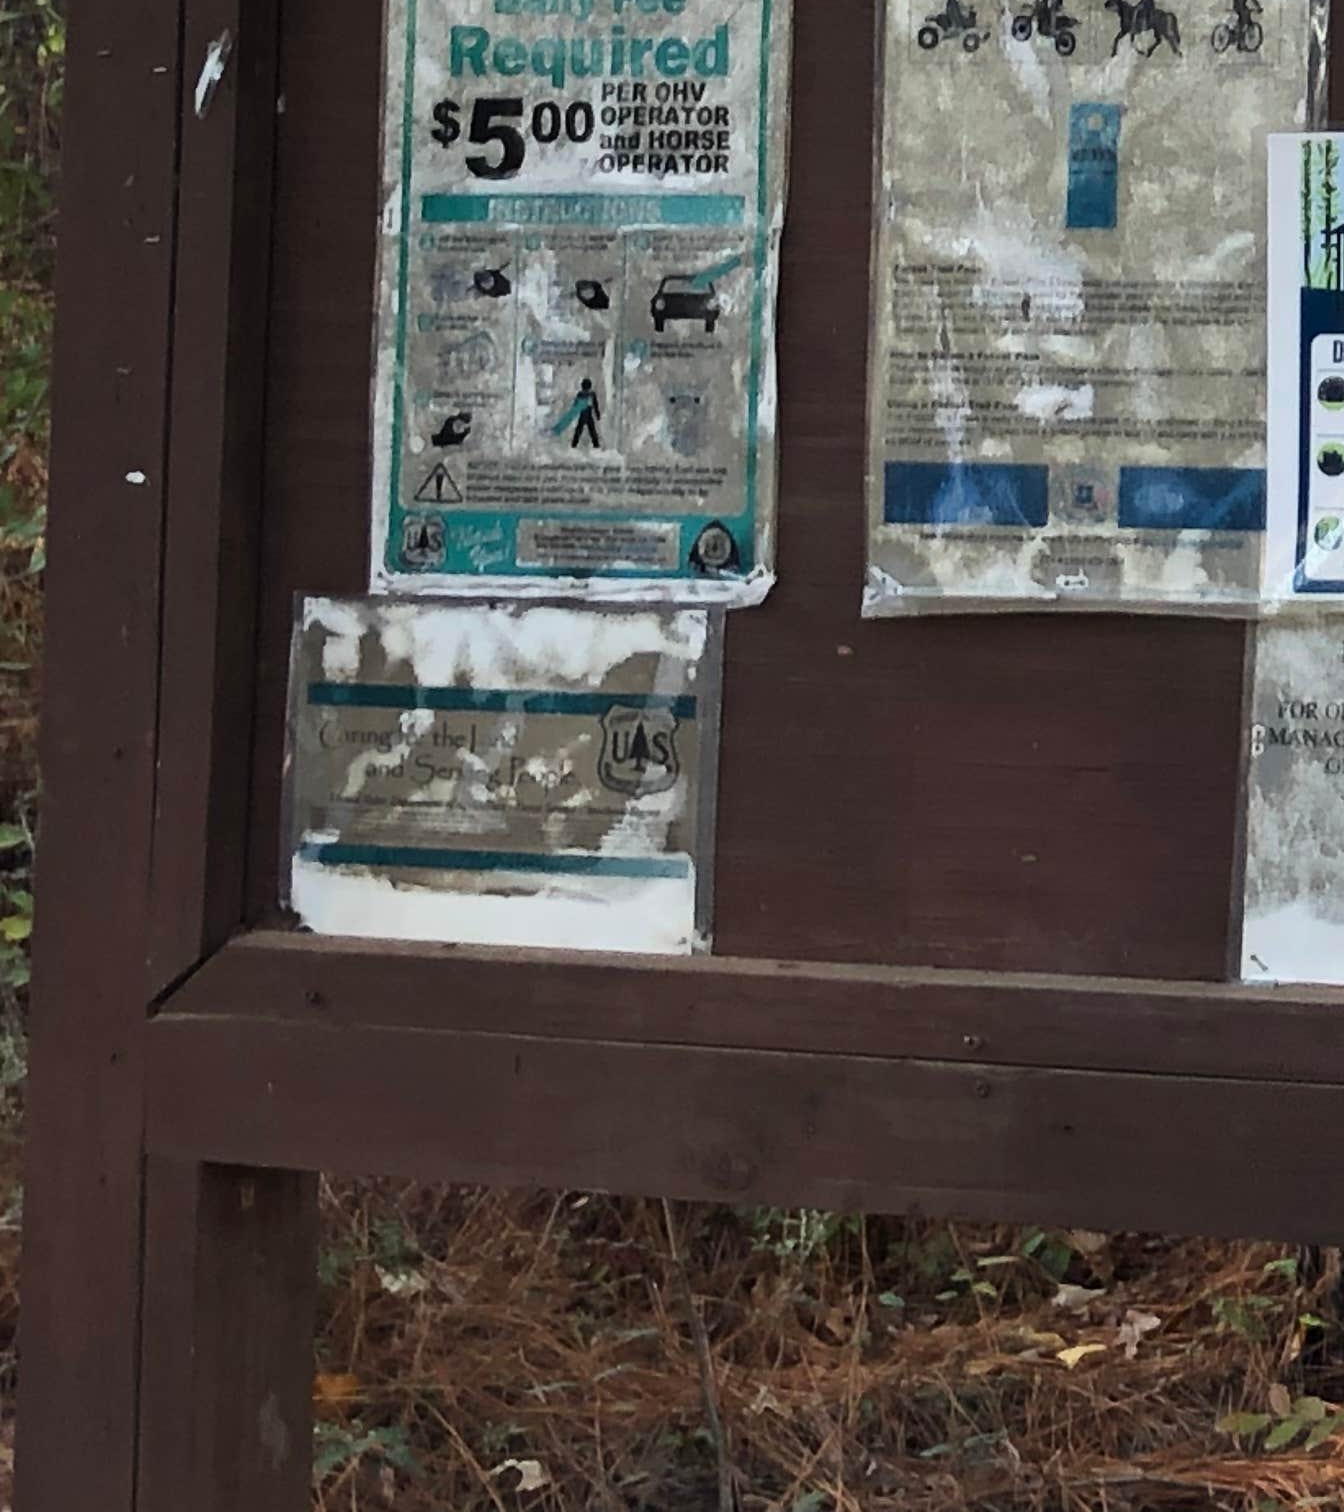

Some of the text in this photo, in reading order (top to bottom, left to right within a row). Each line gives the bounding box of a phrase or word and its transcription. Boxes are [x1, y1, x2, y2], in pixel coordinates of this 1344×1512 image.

[449, 24, 730, 88] Required
[602, 82, 706, 104] PER OHV
[600, 106, 730, 127] OPERATOR
[600, 130, 730, 150] and HORSE
[599, 154, 729, 175] OPERATOR
[1278, 702, 1317, 721] FOR
[365, 754, 405, 778] and
